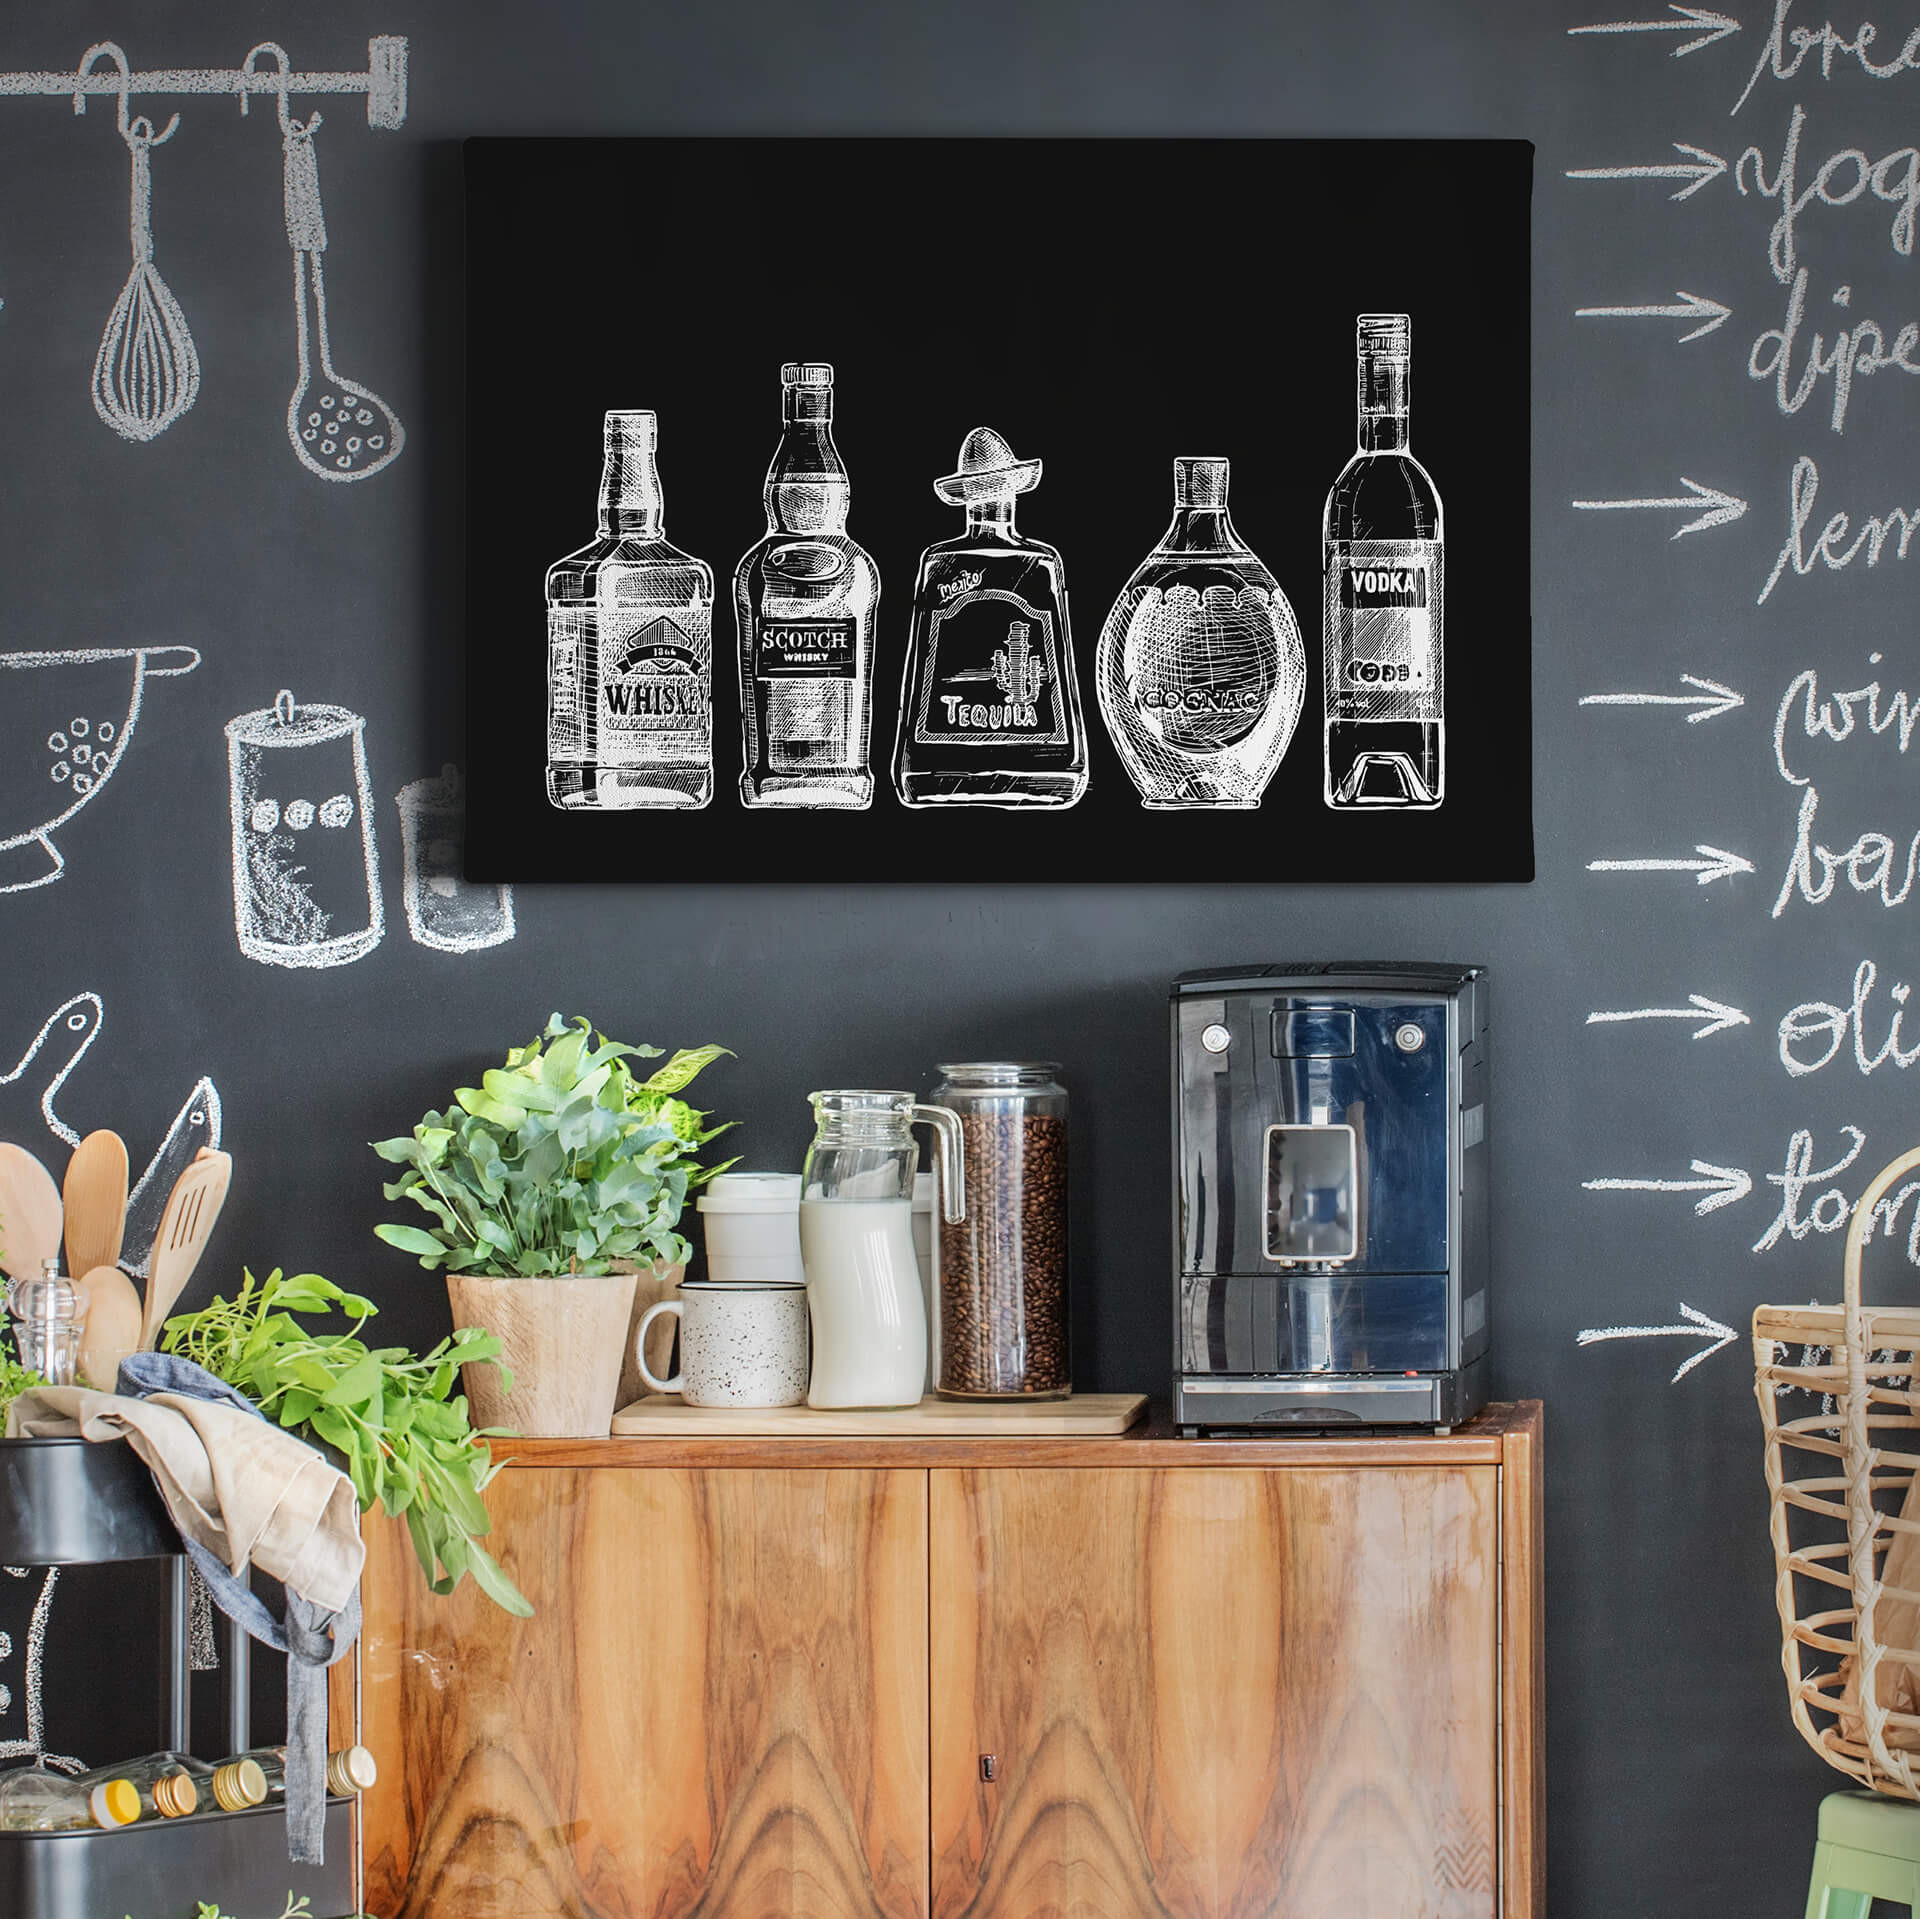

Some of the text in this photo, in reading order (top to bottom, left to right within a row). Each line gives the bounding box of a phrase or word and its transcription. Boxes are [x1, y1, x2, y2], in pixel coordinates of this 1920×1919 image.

[1730, 0, 1920, 116] bre
[1351, 570, 1416, 593] VODKA
[762, 627, 848, 652] SCOTCH
[784, 652, 829, 662] WHISKY
[940, 695, 1038, 729] TEQUILA
[1144, 690, 1260, 713] COGNAC
[1772, 786, 1920, 919] ba
